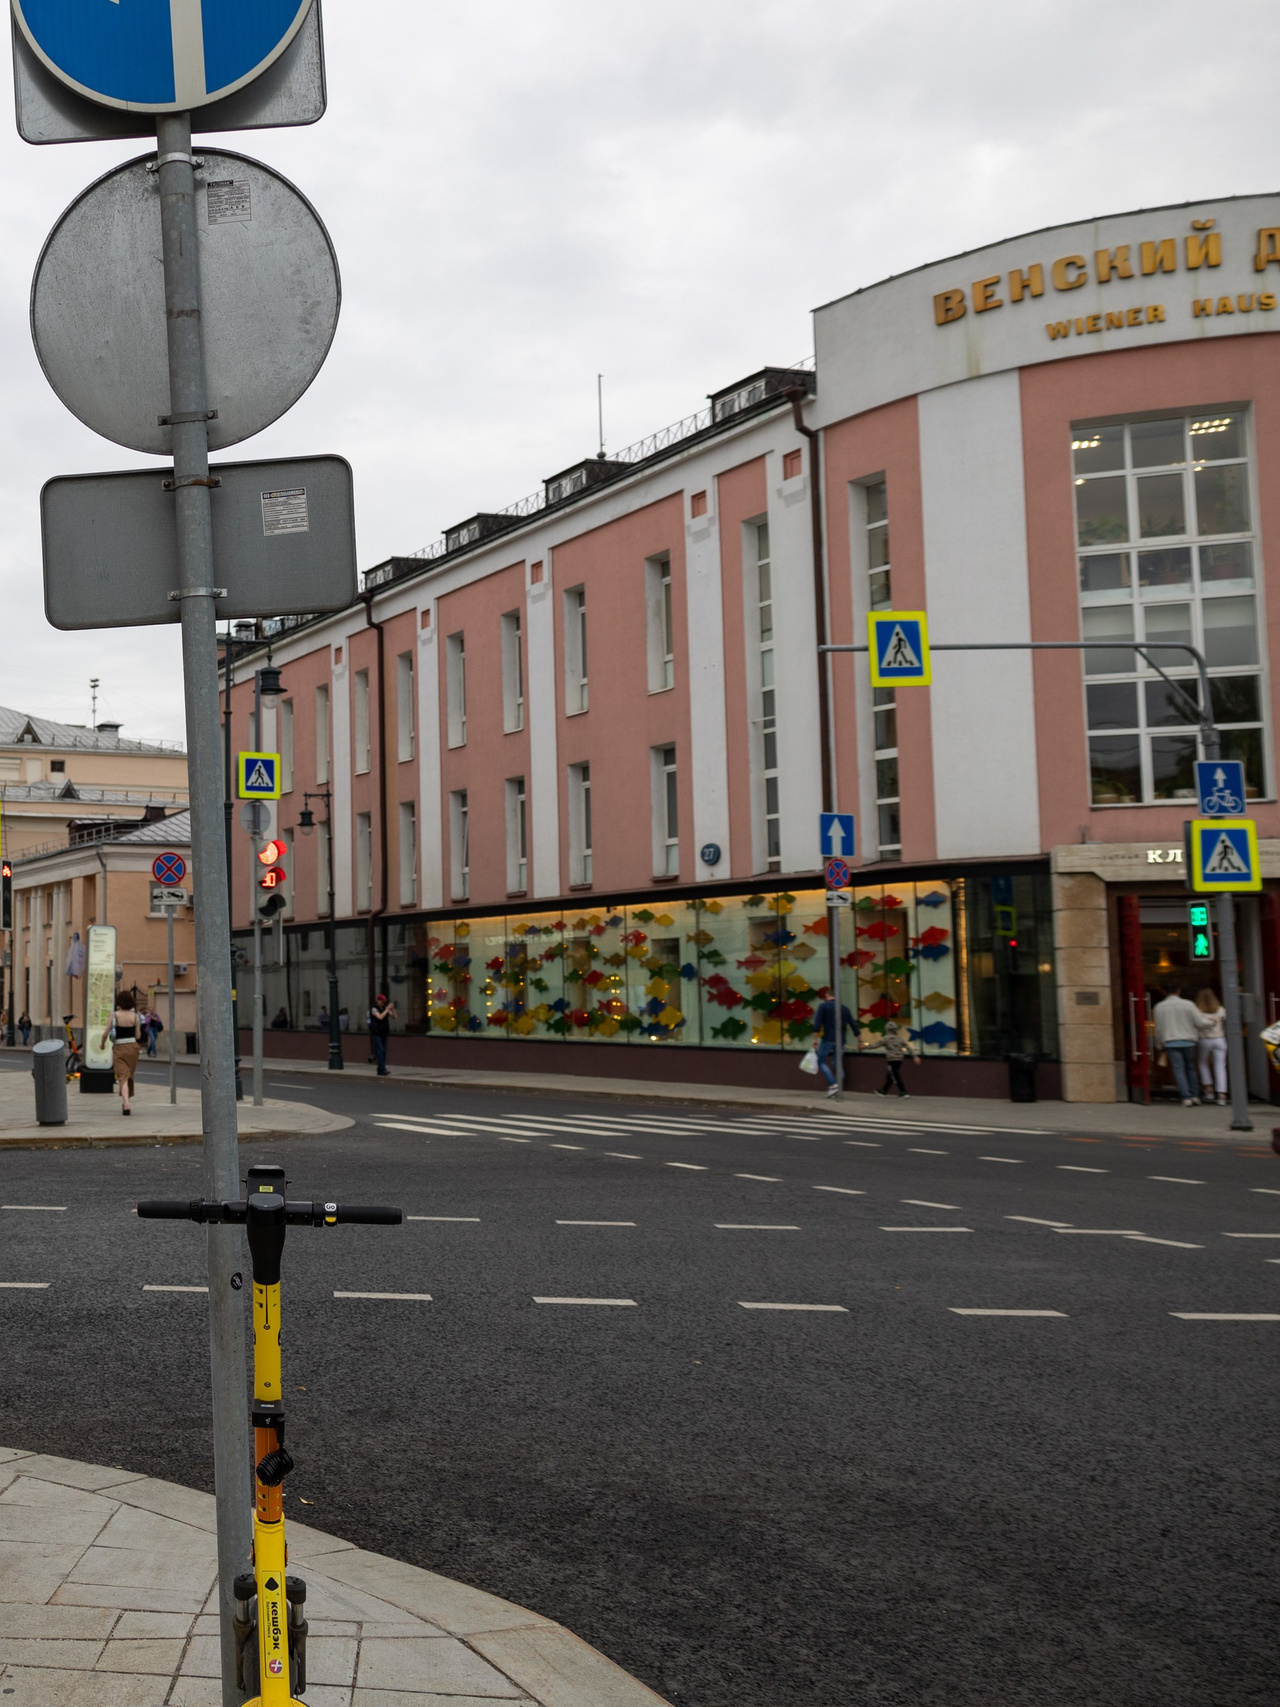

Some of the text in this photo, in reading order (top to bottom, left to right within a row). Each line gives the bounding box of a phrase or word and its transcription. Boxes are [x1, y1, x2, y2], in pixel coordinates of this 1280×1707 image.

[933, 219, 1222, 326] ВЕНСКИЙ
[1045, 292, 1278, 340] WIENER HAUS
[703, 848, 714, 860] 27
[271, 1601, 281, 1650] кешбэк
